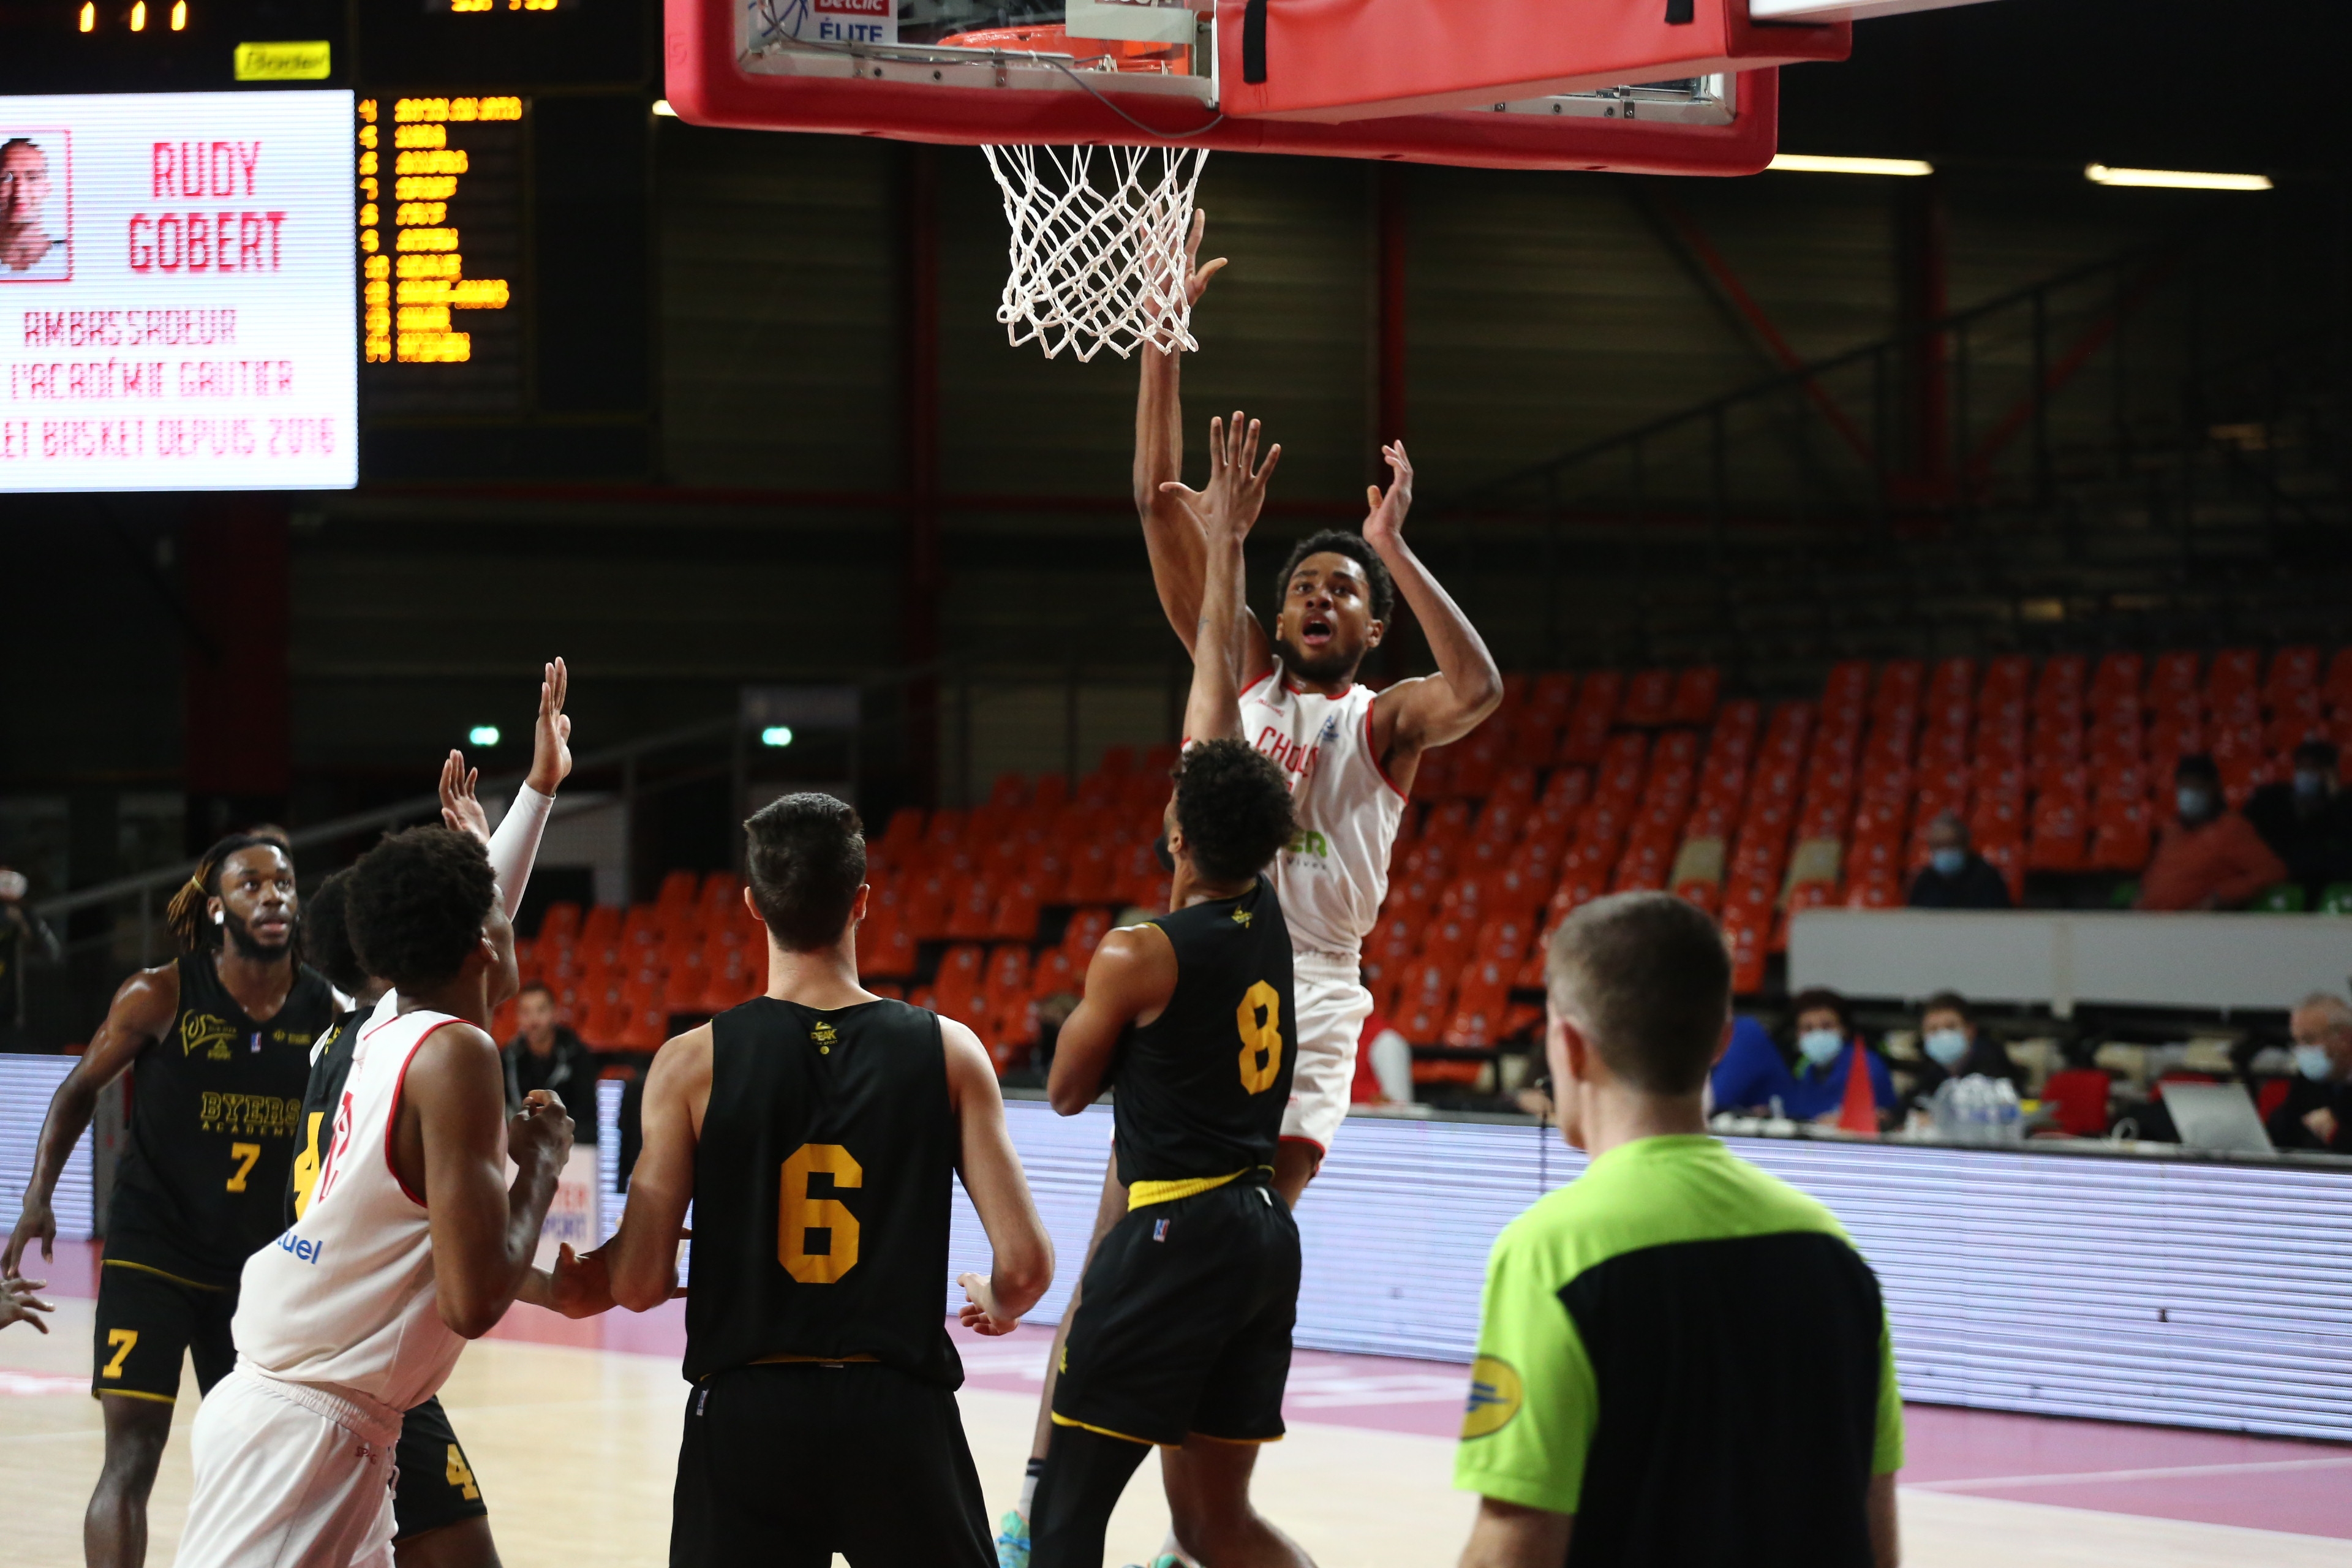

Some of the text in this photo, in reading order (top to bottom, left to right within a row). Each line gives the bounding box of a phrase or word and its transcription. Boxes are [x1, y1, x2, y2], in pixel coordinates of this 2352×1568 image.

[151, 141, 263, 197] RUDY
[127, 211, 287, 273] GOBERT
[23, 309, 238, 347] AMBASSADEUR
[179, 360, 293, 397] GAUTIER
[43, 420, 143, 456] BASKET
[158, 418, 255, 455] DEPUIS
[268, 417, 336, 454] 2016
[1237, 979, 1282, 1095] 8
[201, 1091, 301, 1126] BYERS
[202, 1121, 296, 1137] ACADEMY
[227, 1142, 261, 1193] 7
[777, 1143, 862, 1284] 6
[277, 1231, 323, 1265] uel
[102, 1328, 138, 1379] 7
[446, 1443, 480, 1501] 4
